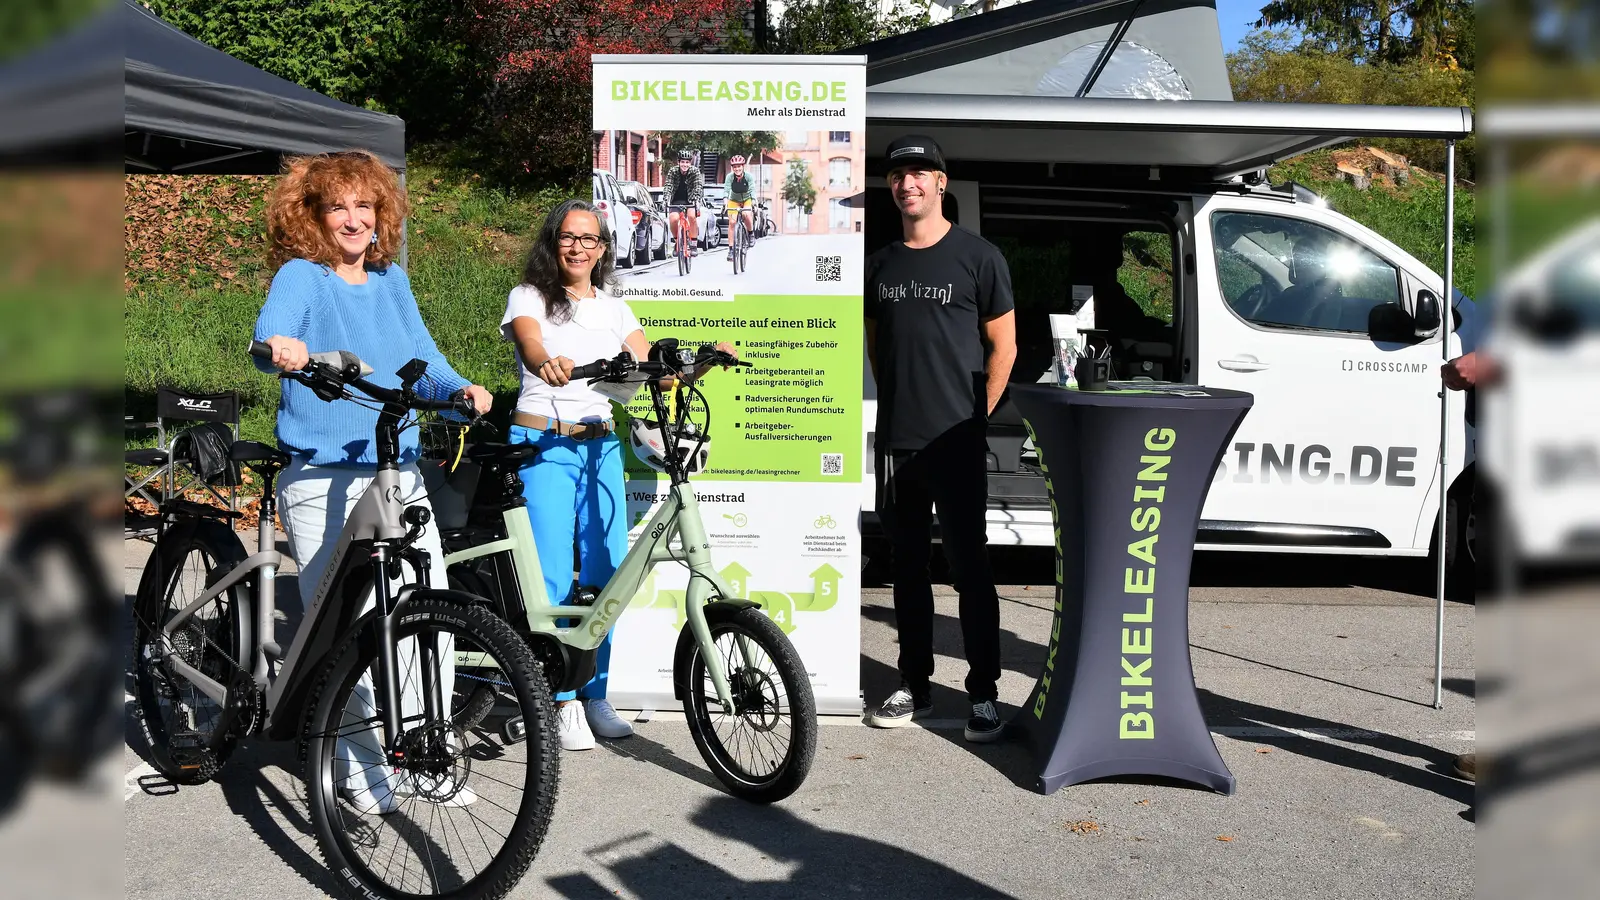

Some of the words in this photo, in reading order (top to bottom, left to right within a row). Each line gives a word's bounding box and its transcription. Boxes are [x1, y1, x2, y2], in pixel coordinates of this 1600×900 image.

[611, 80, 847, 102] BIKELEASING.DE
[747, 107, 776, 117] Mehr
[778, 107, 793, 117] als
[794, 107, 846, 117] Dienstrad
[638, 316, 747, 328] Dienstrad-Vorteile
[749, 317, 769, 328] auf
[770, 318, 804, 328] einen
[806, 318, 837, 329] Blick
[745, 340, 804, 350] Leasingfähiges
[805, 340, 839, 349] Zubehör
[745, 351, 781, 359] inklusive
[745, 367, 814, 377] Arbeitgeberanteil
[1357, 360, 1428, 374] CROSSCAMP
[745, 378, 791, 388] Leasingrate
[792, 378, 824, 388] möglich
[177, 398, 212, 409] XLC
[745, 394, 820, 405] Radversicherungen
[821, 395, 834, 403] für
[745, 405, 785, 414] optimalen
[786, 406, 845, 414] Rundumschutz
[745, 422, 794, 431] Arbeitgeber-
[745, 432, 832, 443] Ausfallversicherungen
[710, 468, 801, 476] bikeleasing.de/leasingrechner
[632, 491, 658, 504] Weg
[313, 548, 341, 609] KALKHOFF
[1119, 426, 1177, 741] BIKELEASING
[730, 579, 740, 594] 3
[821, 581, 831, 596] 5
[773, 610, 786, 623] 4
